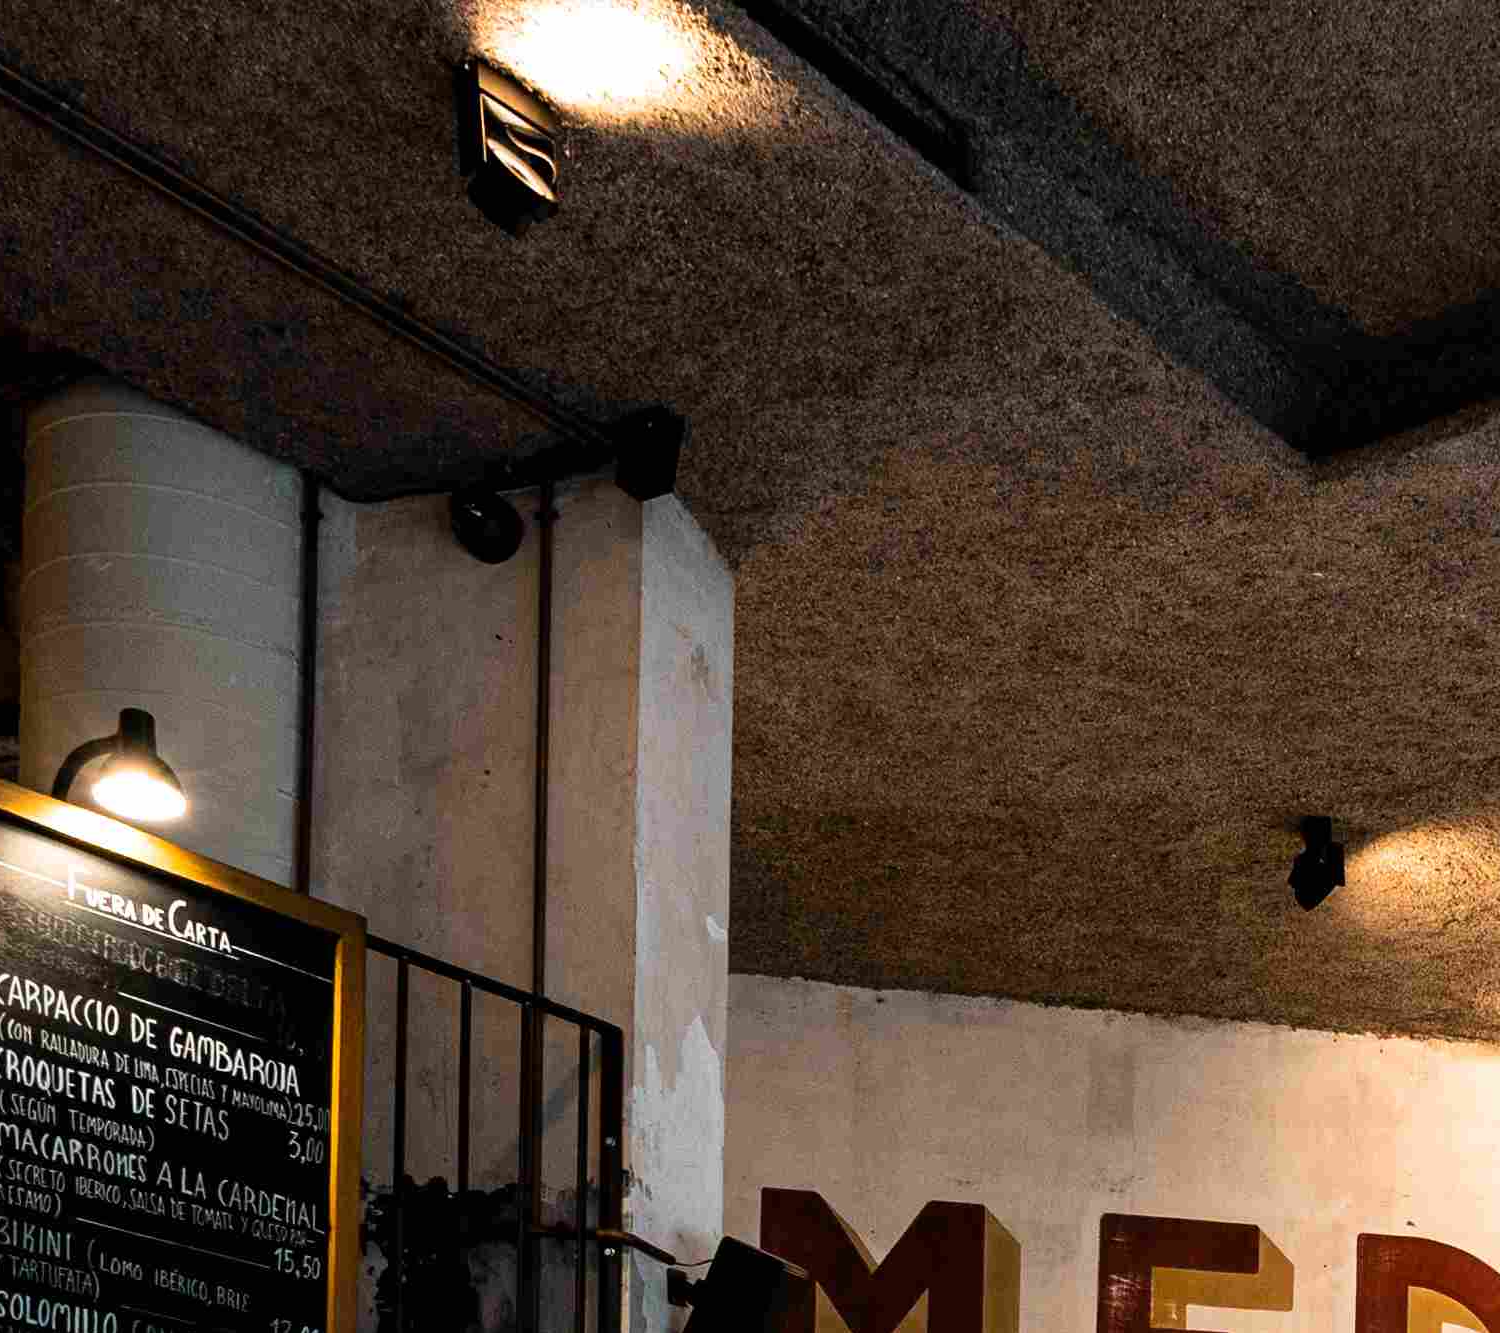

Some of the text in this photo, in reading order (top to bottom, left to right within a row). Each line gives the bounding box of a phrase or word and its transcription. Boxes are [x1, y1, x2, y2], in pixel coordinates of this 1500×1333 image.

[142, 903, 165, 929] DE
[167, 900, 232, 953] CARTA
[40, 1030, 110, 1070] RALLADURA
[114, 1051, 130, 1075] DE
[131, 1012, 158, 1050] DE
[131, 1085, 156, 1120] DE
[164, 1095, 229, 1142] SETAS
[156, 1161, 173, 1189] A
[181, 1167, 207, 1201] LA
[218, 1178, 325, 1234] CARDENAL
[169, 1201, 188, 1222] DE
